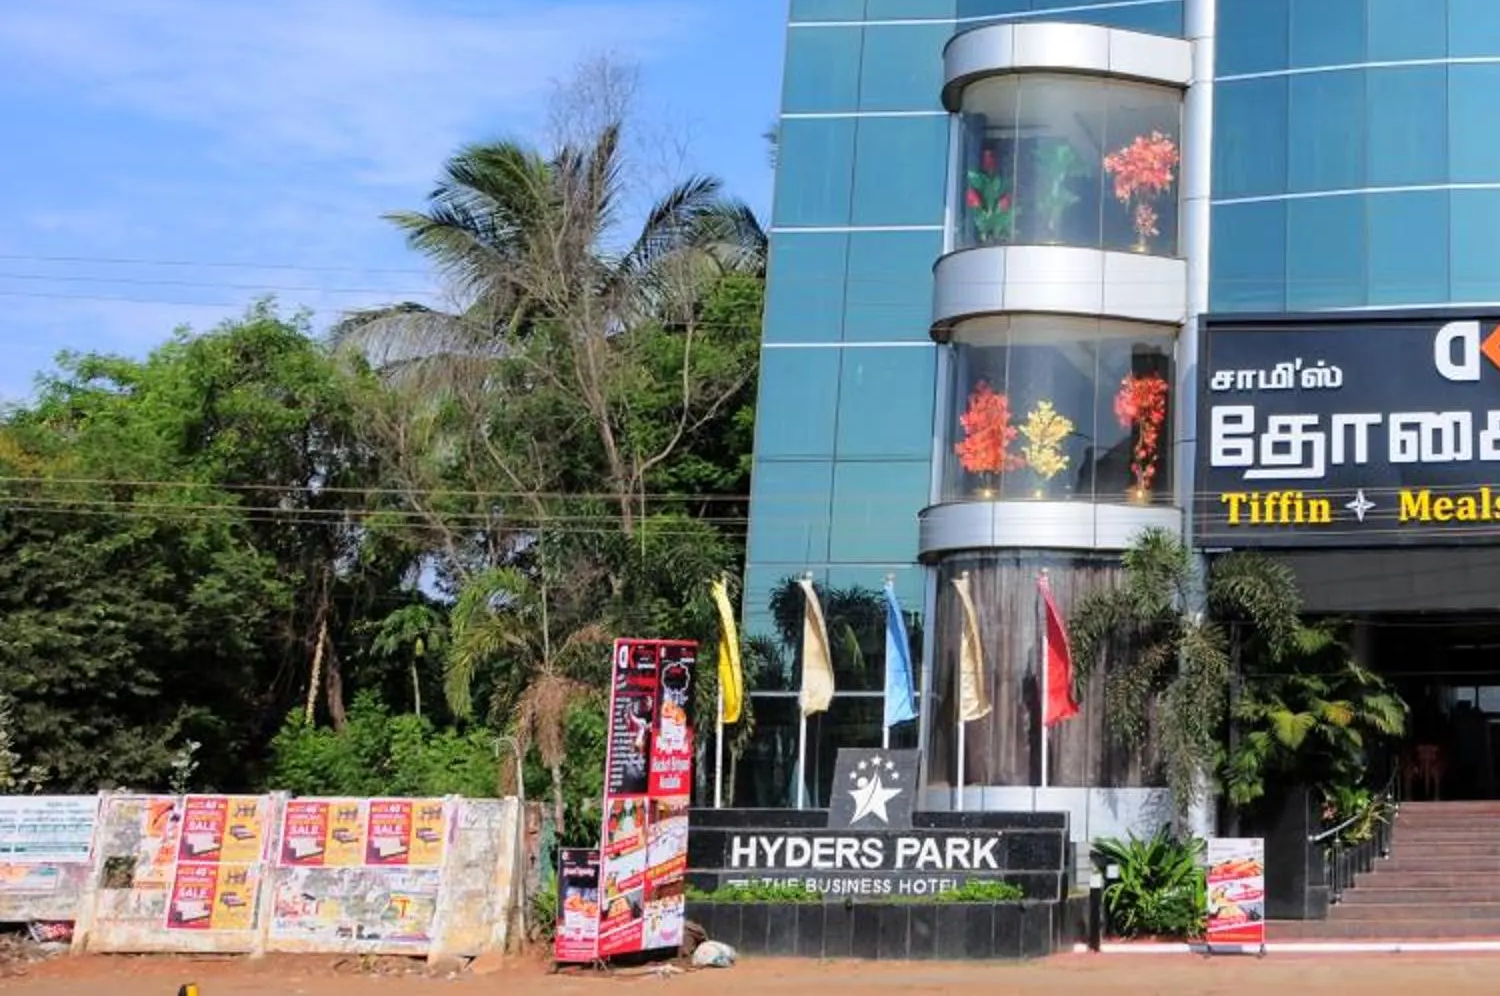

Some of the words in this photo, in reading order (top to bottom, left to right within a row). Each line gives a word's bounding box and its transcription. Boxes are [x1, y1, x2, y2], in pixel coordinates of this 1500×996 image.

[1221, 489, 1332, 525] Tiffin
[731, 835, 883, 869] HYDERS
[896, 836, 1000, 869] PARK
[805, 877, 891, 895] BUSINESS
